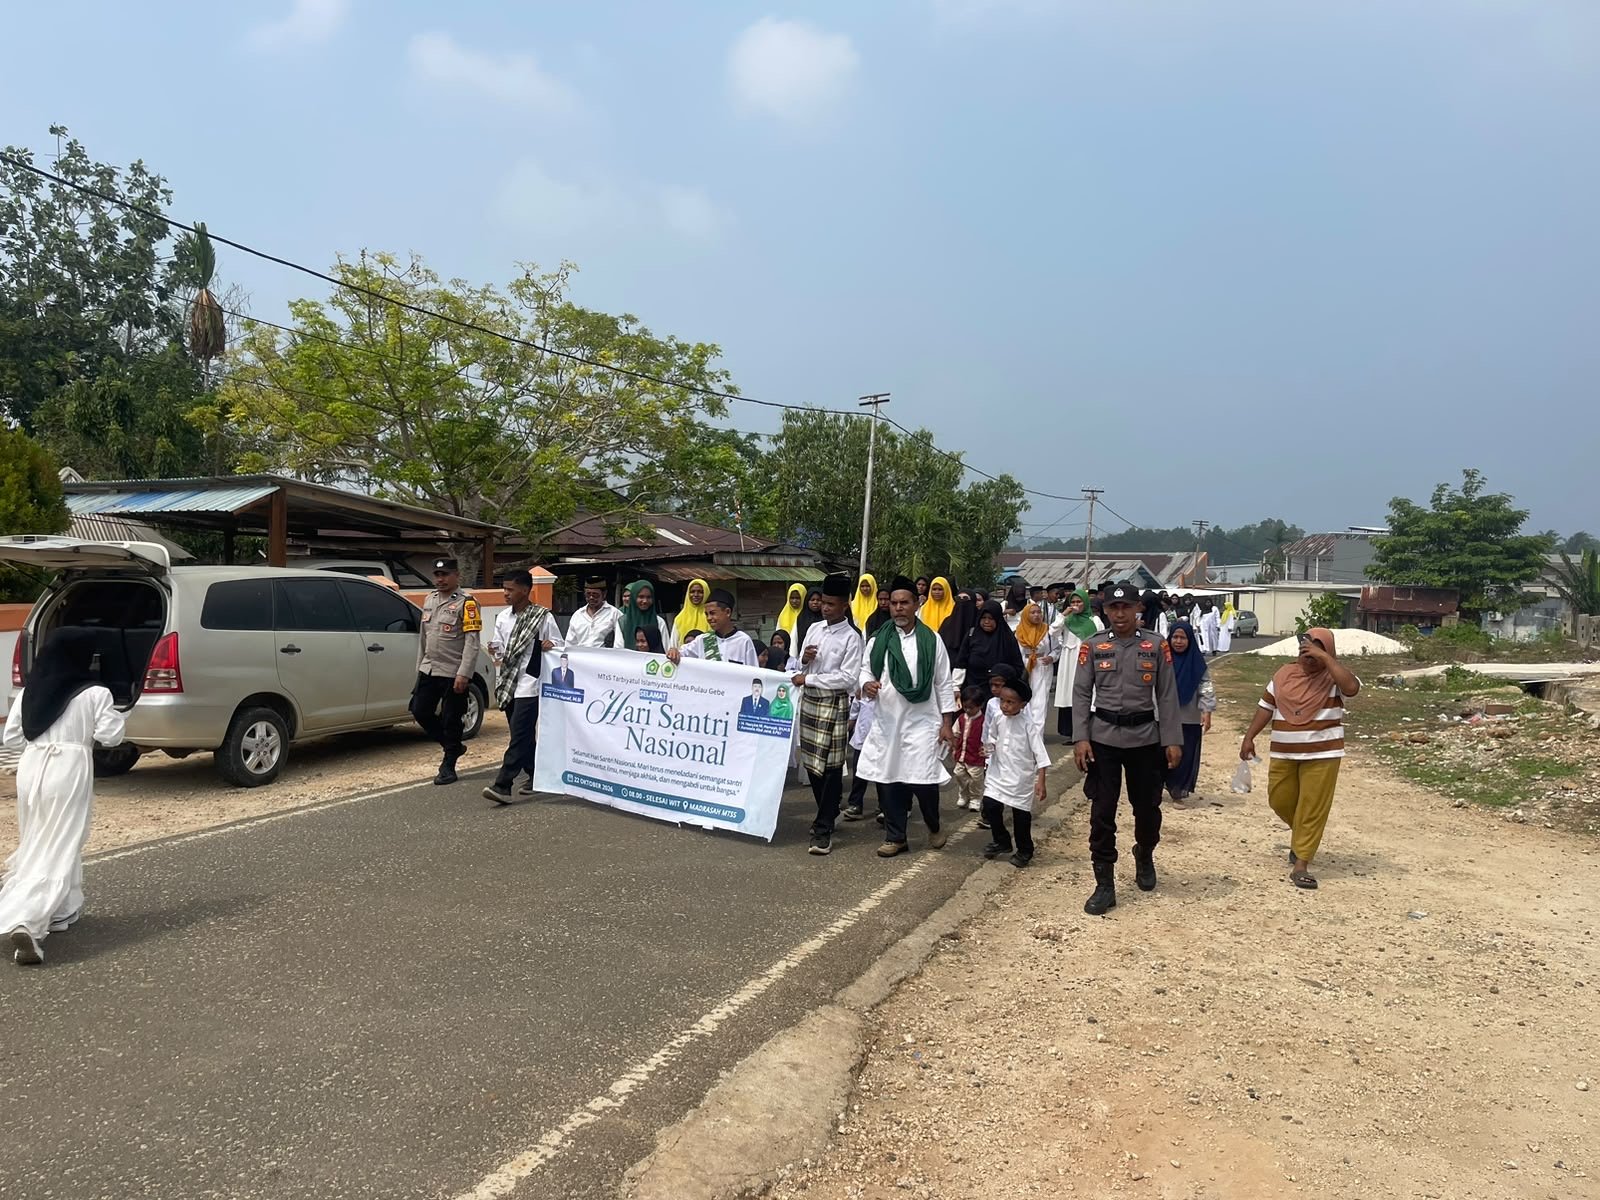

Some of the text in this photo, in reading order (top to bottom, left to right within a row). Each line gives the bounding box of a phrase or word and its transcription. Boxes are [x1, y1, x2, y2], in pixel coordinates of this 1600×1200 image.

[598, 673, 725, 696] MTsS Tarbiyatul Islamiyatul Huda Pulau Gebe
[640, 690, 667, 700] SELAMAT
[586, 689, 729, 738] Hari Santri
[624, 725, 727, 766] Nasional
[591, 753, 600, 761] Hari
[600, 755, 614, 763] Santri
[637, 762, 650, 770] Mari
[650, 765, 664, 773] terus
[665, 768, 698, 779] meneladani
[699, 773, 726, 785] semangat
[727, 778, 742, 787] santri
[618, 769, 640, 779] menjaga
[640, 772, 658, 782] akhlak,
[671, 779, 699, 788] mengabdi
[700, 784, 716, 792] untuk
[580, 778, 601, 790] OKTOBER
[646, 794, 668, 805] SELESAI
[669, 799, 681, 807] WIT
[690, 803, 721, 815] MADRASAH
